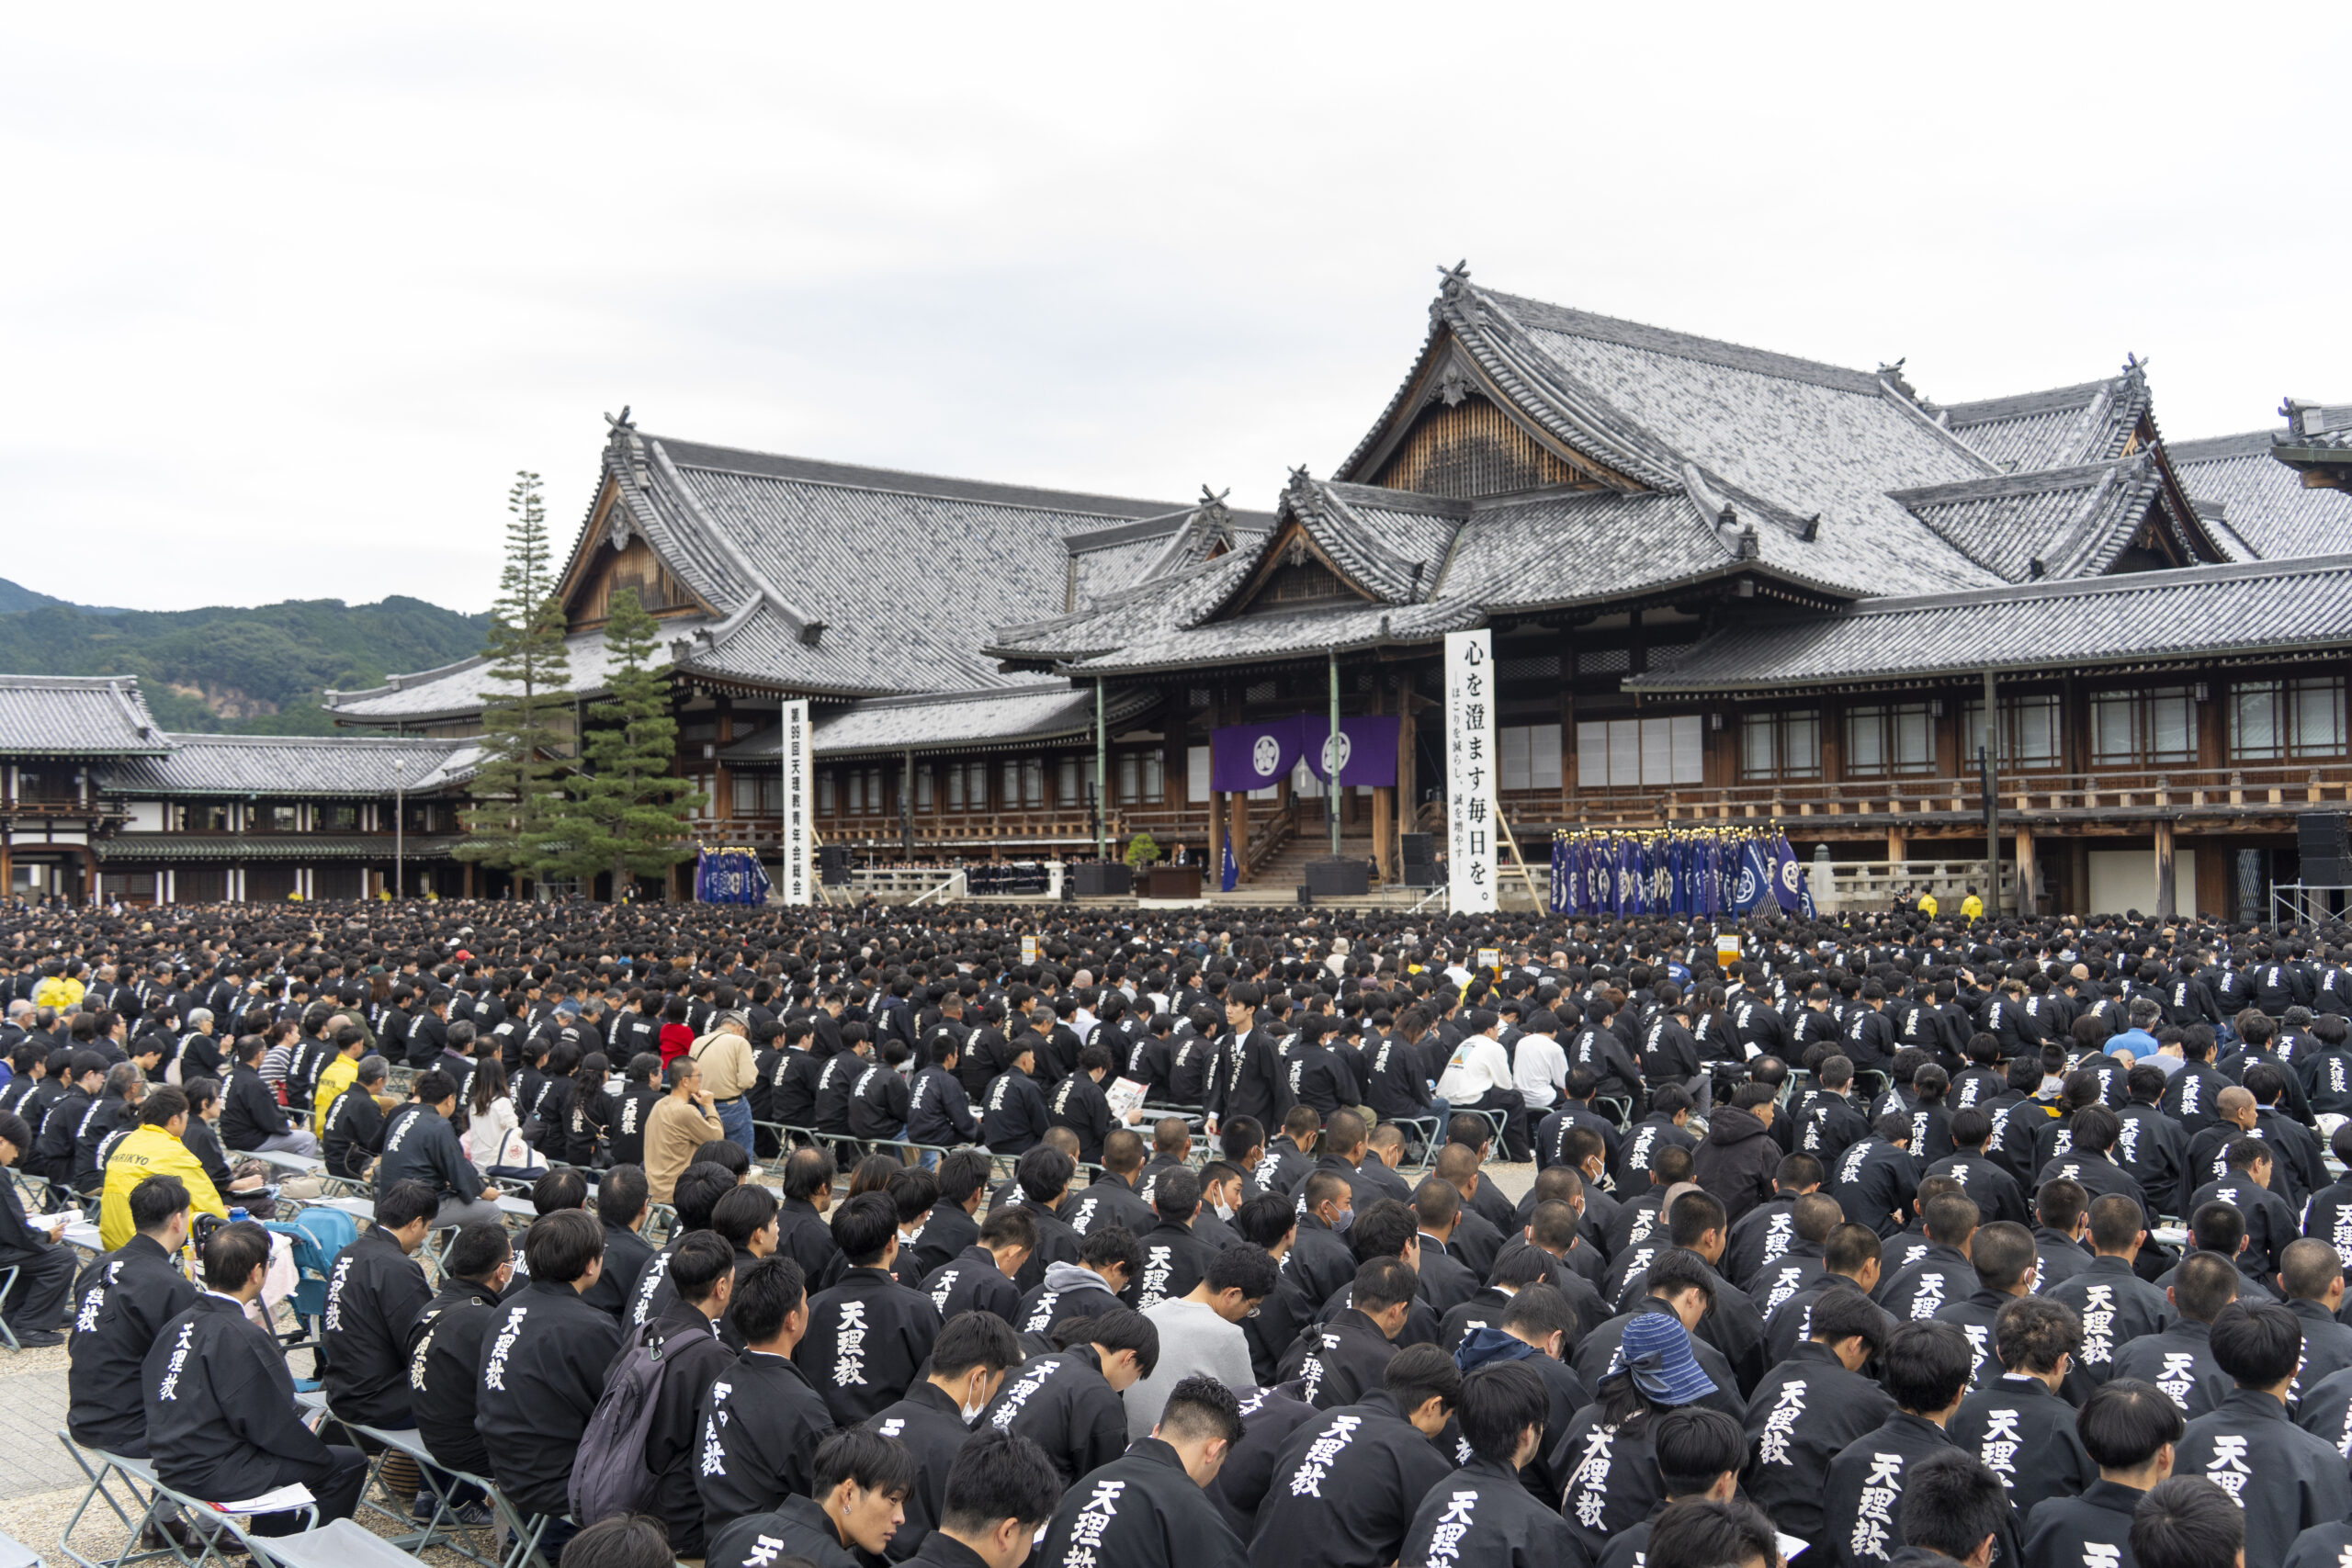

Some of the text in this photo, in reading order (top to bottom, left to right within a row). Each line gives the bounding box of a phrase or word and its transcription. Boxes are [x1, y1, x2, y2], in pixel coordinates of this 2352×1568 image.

[1465, 641, 1487, 899] 心を澄ます毎日を。
[1908, 1112, 1928, 1156] 天理教
[2180, 1076, 2200, 1114] 天理教
[1629, 1127, 1657, 1169] 天理教
[1840, 1143, 1872, 1183] 天理教
[326, 1257, 353, 1331] 天理教
[2080, 1285, 2117, 1365] 天理教
[160, 1322, 194, 1400] 天理教
[485, 1307, 527, 1390] 天理教
[832, 1301, 868, 1386] 天理教
[991, 1359, 1061, 1428] 天理教
[1759, 1380, 1806, 1465] 天理教
[1290, 1416, 1362, 1497] 天理教
[1576, 1425, 1617, 1531] 天理教
[1851, 1452, 1903, 1562] 天理教
